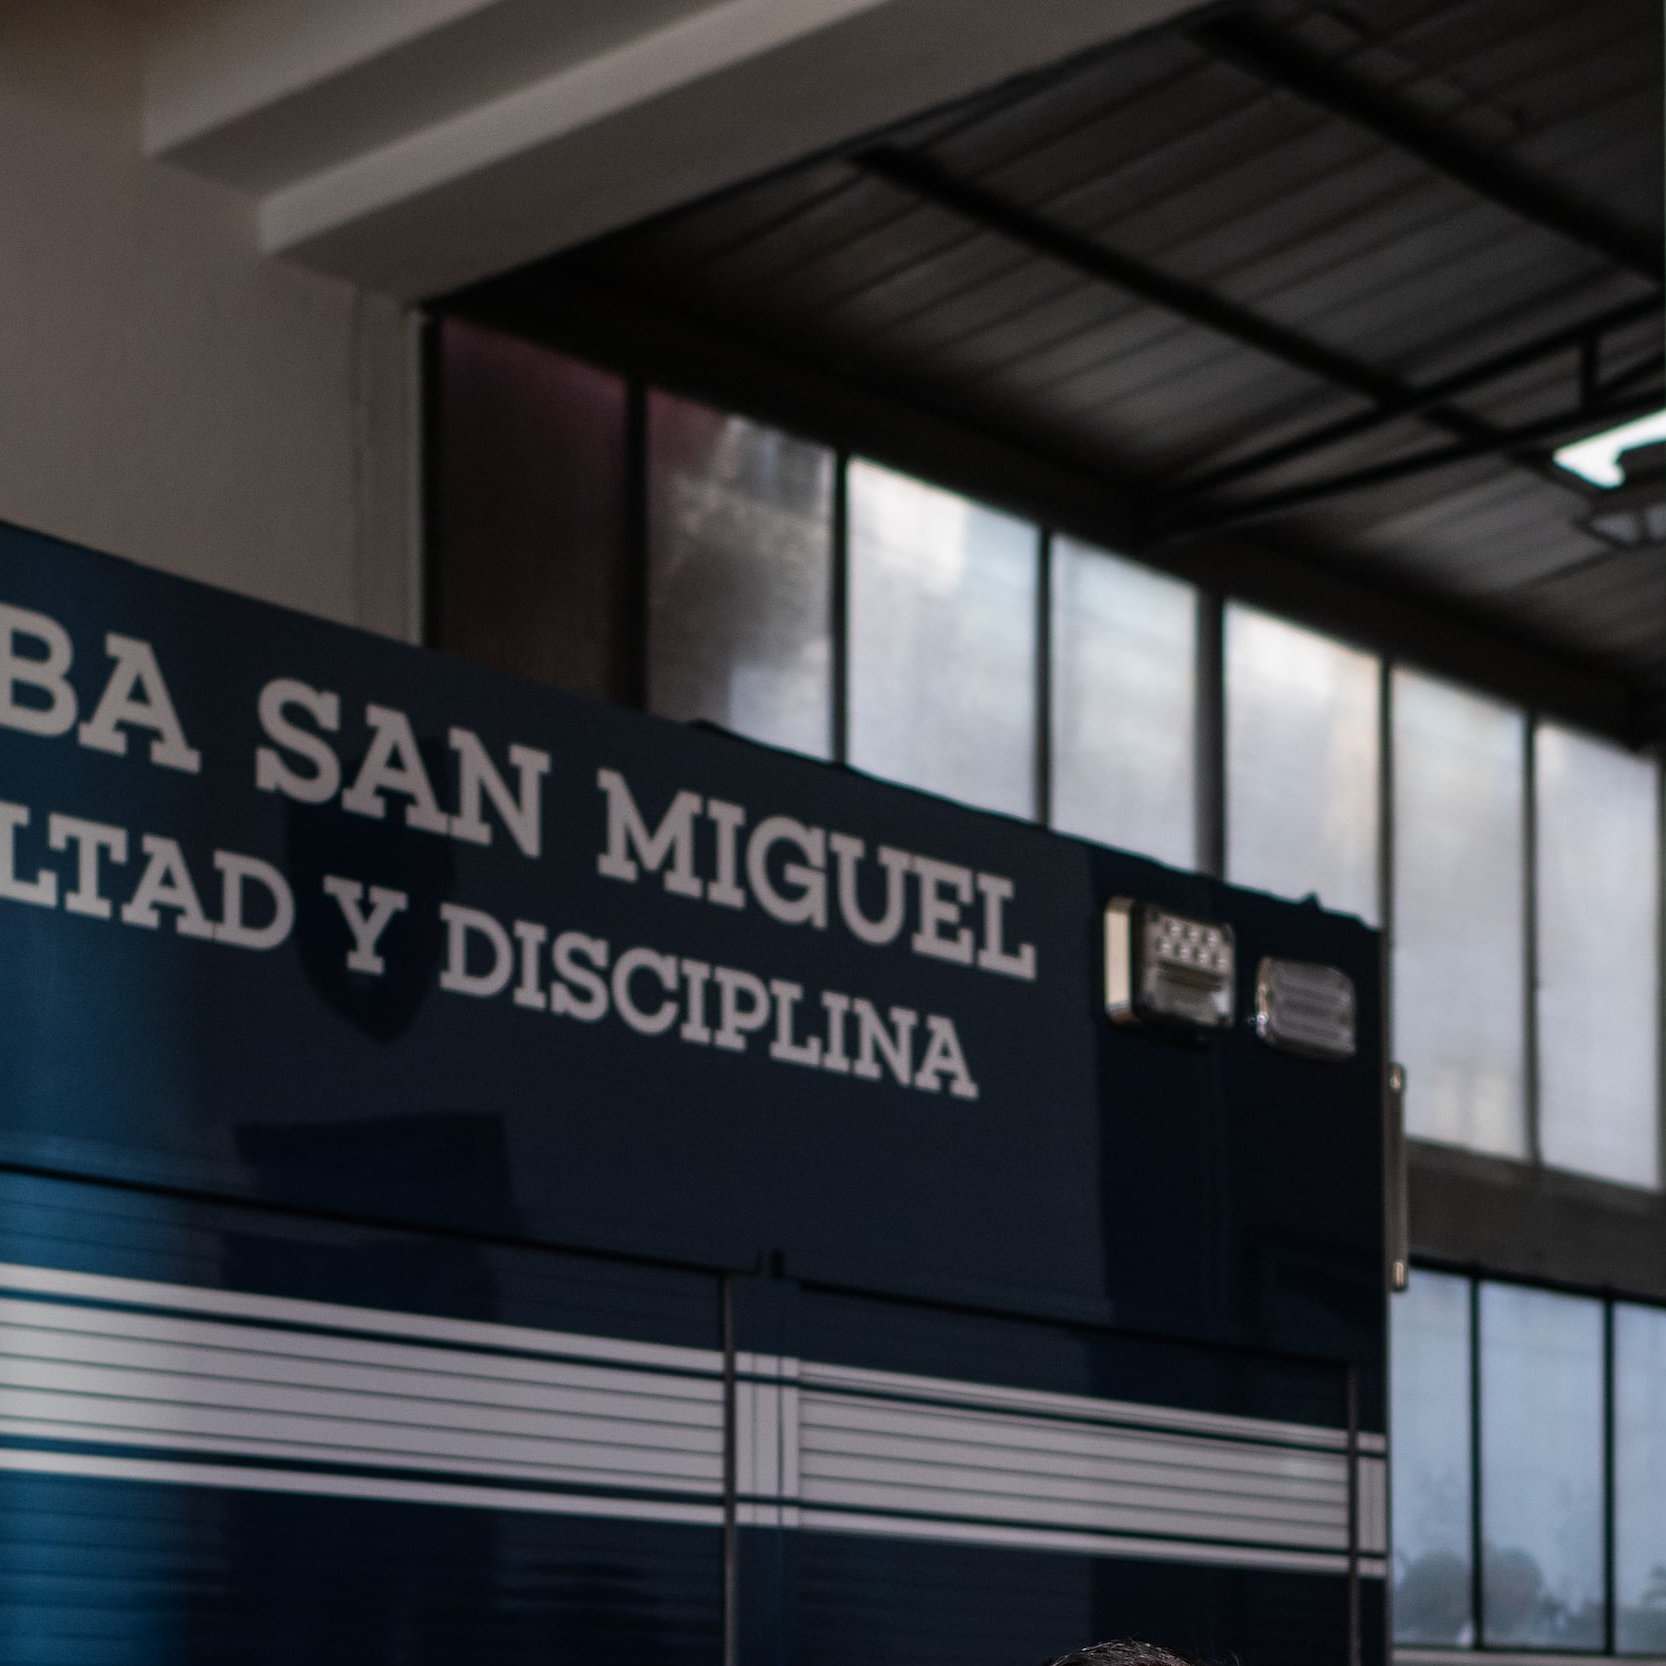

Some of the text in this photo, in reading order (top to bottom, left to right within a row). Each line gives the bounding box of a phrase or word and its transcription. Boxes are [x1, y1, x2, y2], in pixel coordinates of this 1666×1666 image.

[255, 678, 550, 857] SAN
[597, 769, 1037, 981] MIGUEL
[323, 878, 409, 974] Y
[439, 902, 979, 1100] DISCIPLINA
